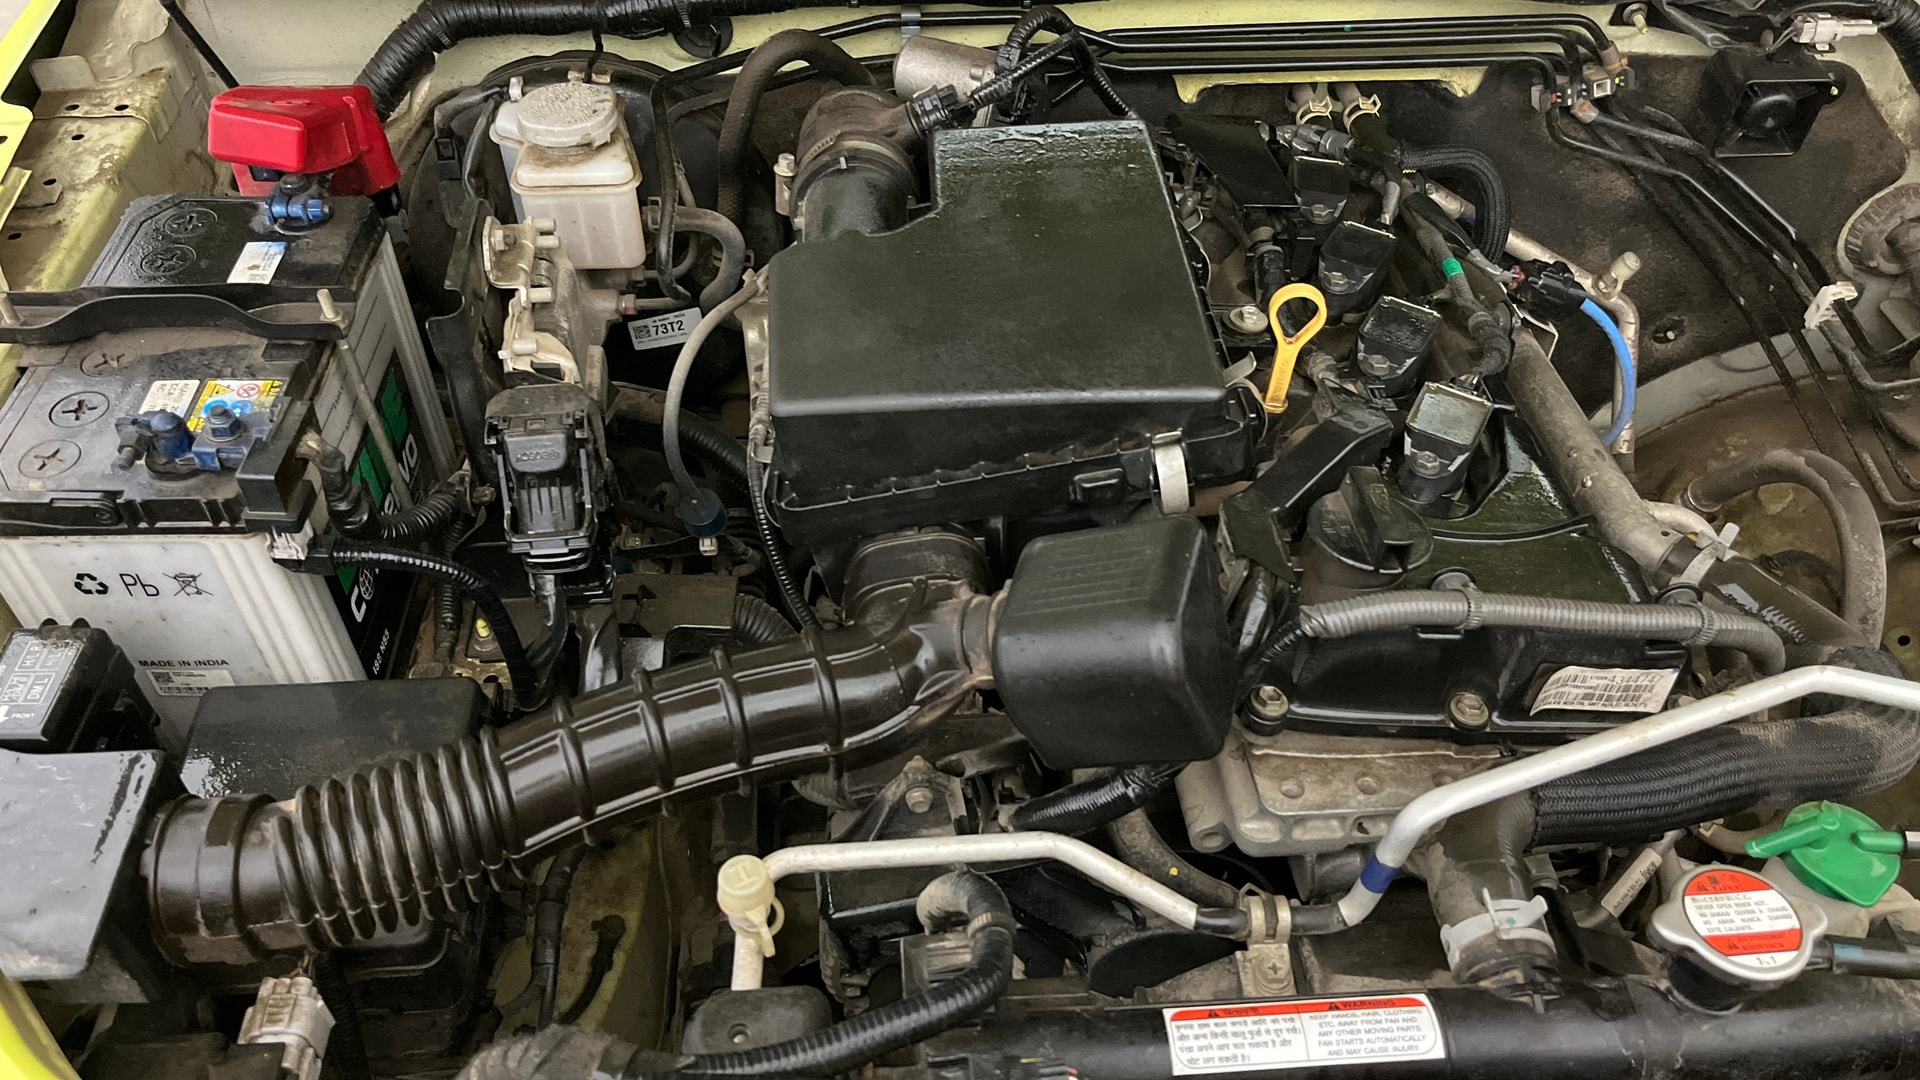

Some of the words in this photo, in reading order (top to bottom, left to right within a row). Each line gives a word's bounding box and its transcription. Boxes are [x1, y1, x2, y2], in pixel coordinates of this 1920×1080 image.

[652, 320, 684, 336] 73T2
[119, 573, 160, 596] Pb
[1340, 1000, 1396, 1008] WARNING
[1366, 1034, 1426, 1044] AUTOMATICALLY
